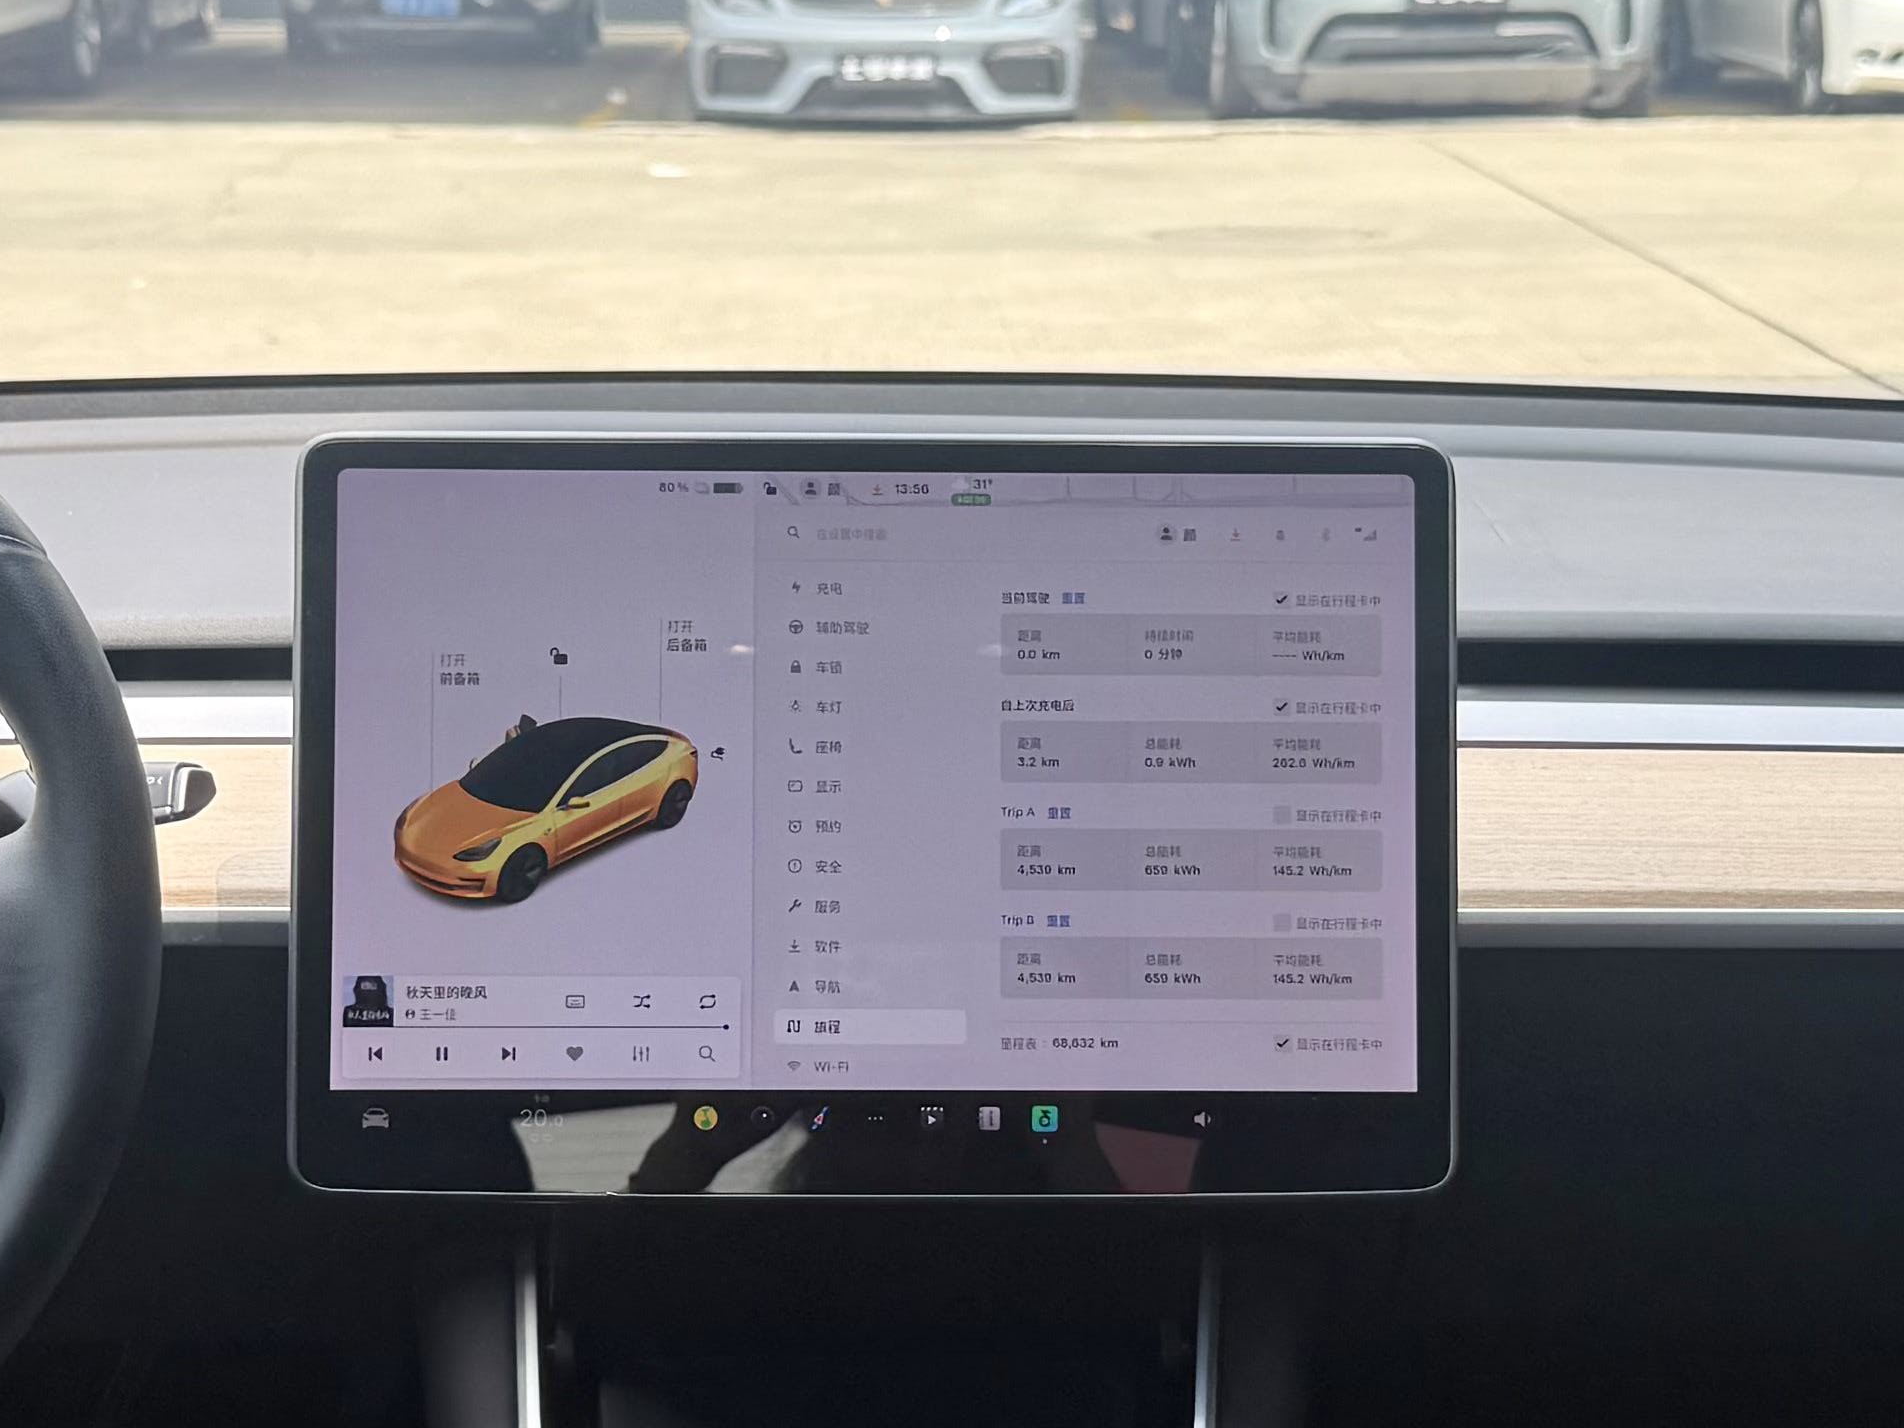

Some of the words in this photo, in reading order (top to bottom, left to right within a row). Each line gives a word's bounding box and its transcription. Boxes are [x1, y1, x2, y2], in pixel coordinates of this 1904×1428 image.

[818, 583, 842, 595] 充电
[667, 638, 706, 652] 后备箱
[816, 701, 842, 714] 车灯
[816, 781, 841, 793] 显示
[816, 860, 841, 873] 安全
